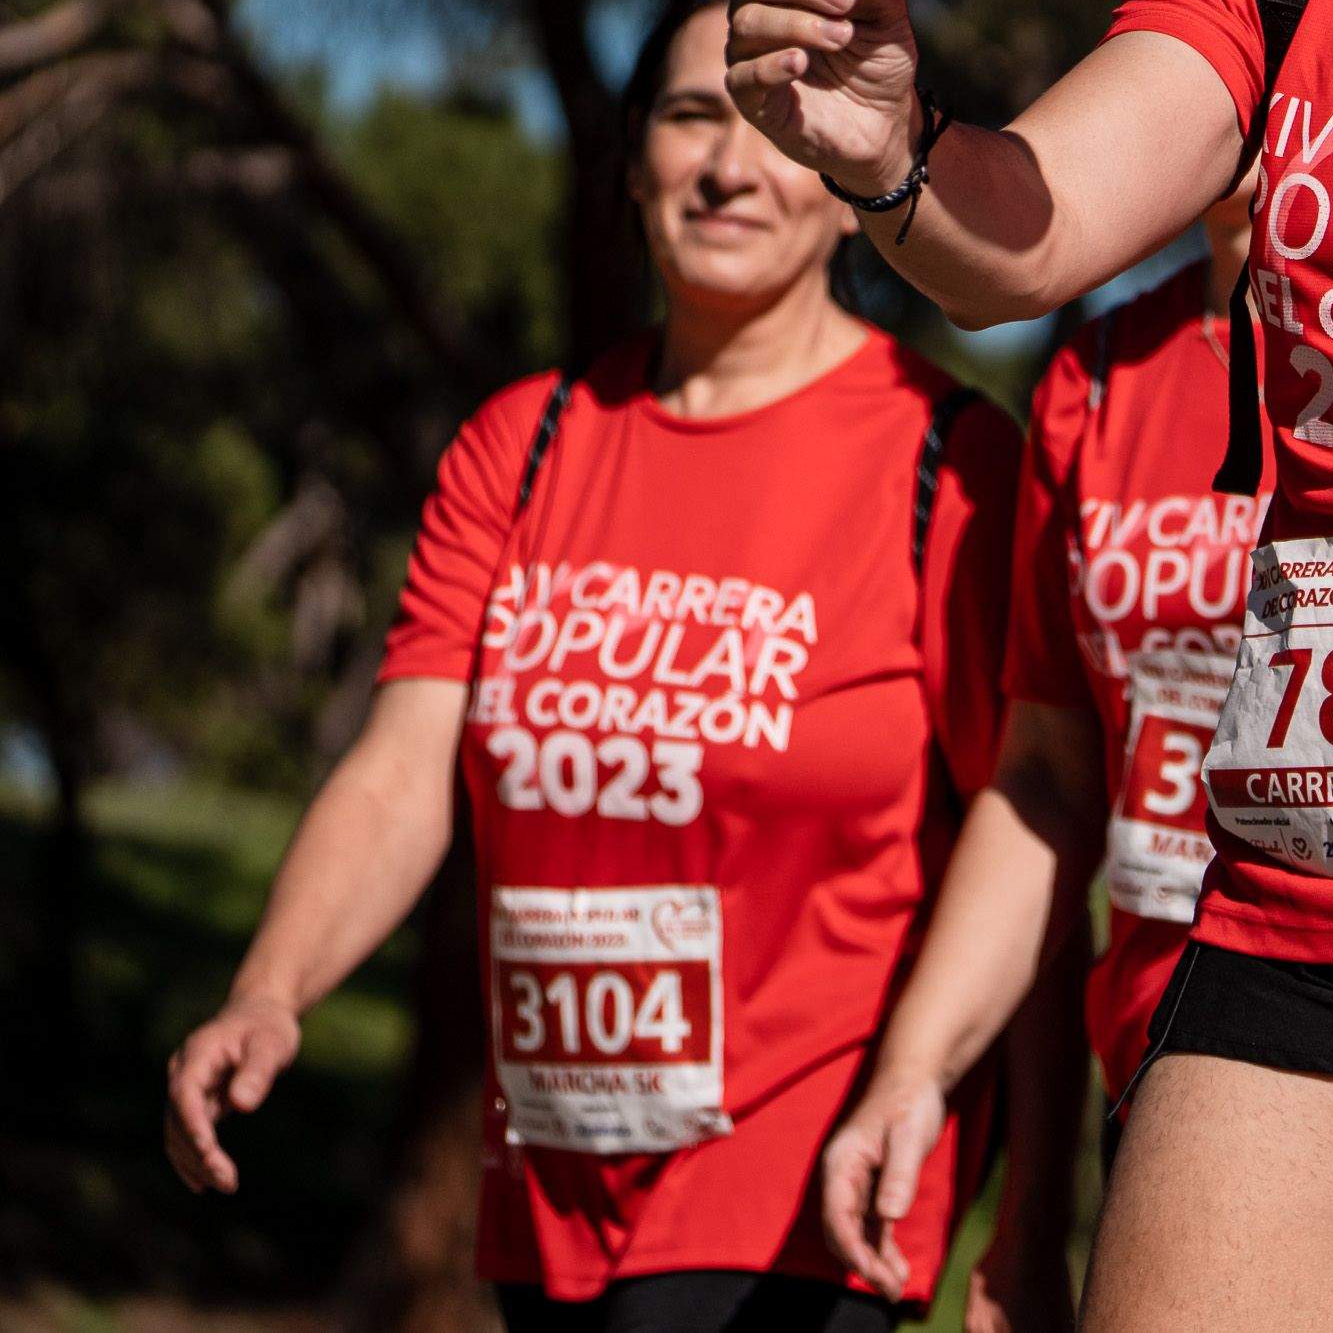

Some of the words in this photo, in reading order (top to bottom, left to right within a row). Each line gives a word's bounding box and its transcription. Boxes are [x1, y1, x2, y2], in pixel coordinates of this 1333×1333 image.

[1249, 265, 1304, 336] EL
[570, 560, 820, 646] CARRERA
[471, 677, 519, 725] EL
[524, 675, 794, 752] CORAZÓN
[486, 728, 705, 827] 2023
[510, 970, 693, 1055] 3104
